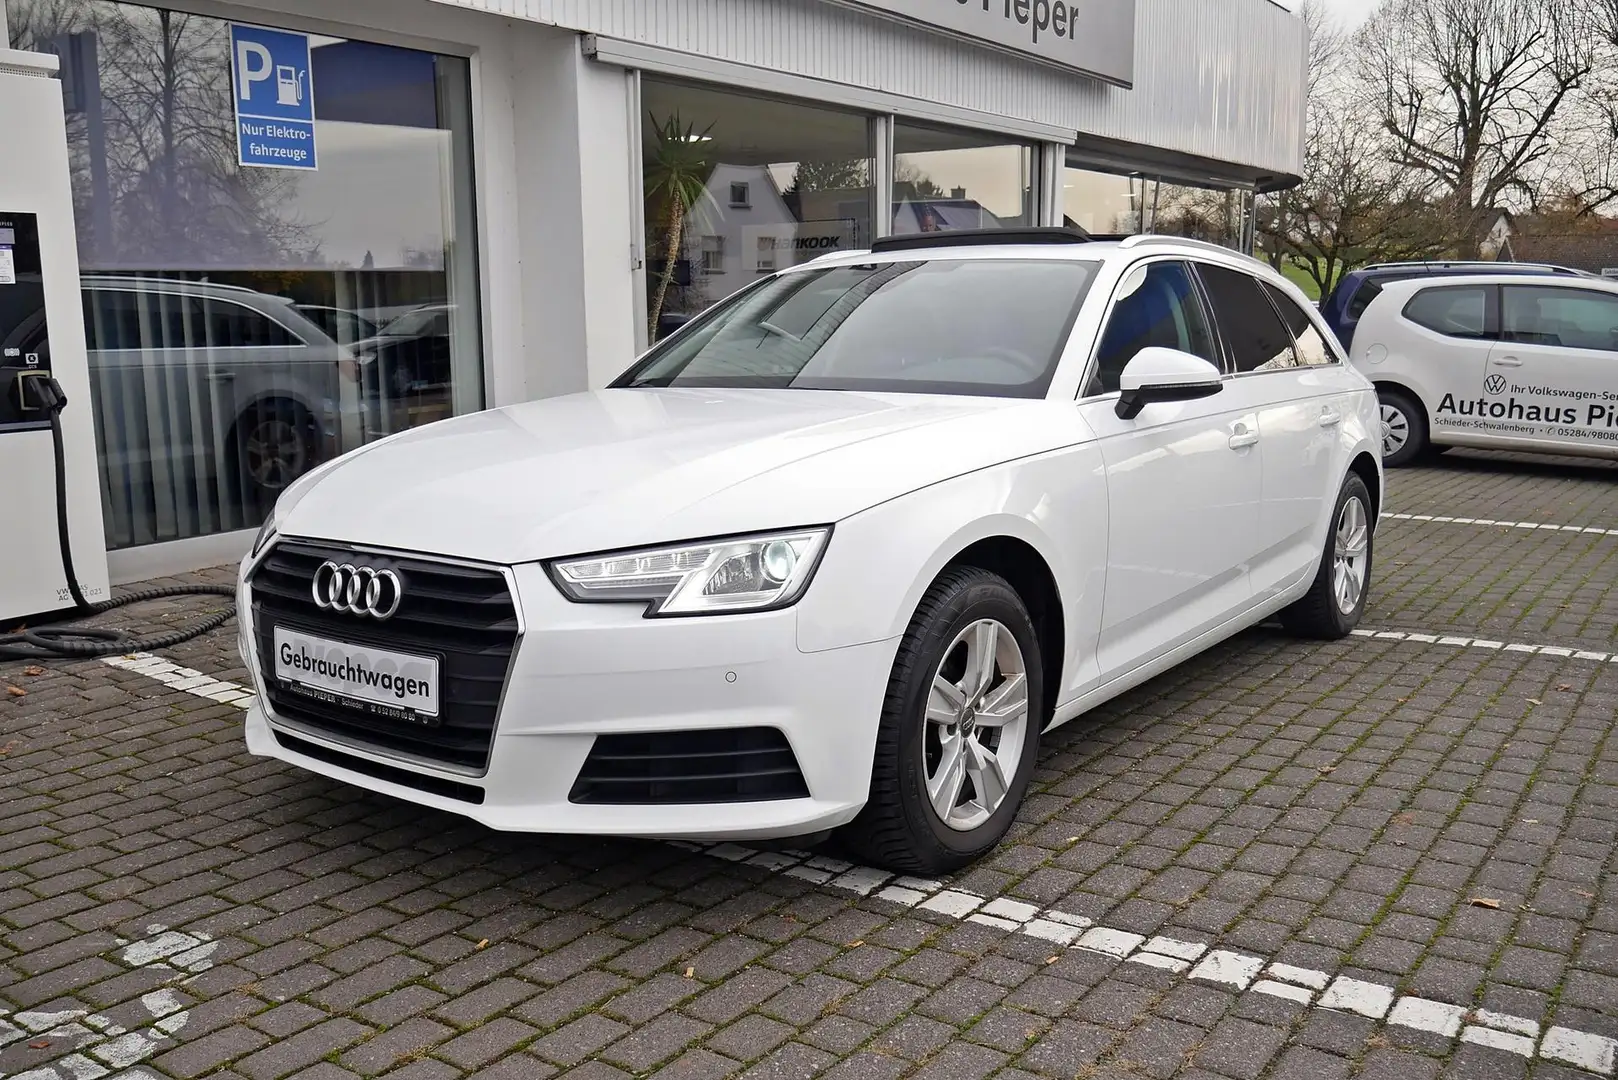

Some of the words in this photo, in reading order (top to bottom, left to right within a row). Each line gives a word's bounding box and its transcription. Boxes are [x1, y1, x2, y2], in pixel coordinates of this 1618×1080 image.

[236, 40, 272, 100] P
[241, 123, 265, 136] Nur
[266, 125, 311, 139] Elektro-
[249, 143, 307, 161] fahrzeuge
[1510, 384, 1526, 394] Ihr
[1436, 393, 1577, 425] Autohaus
[1587, 404, 1618, 427] Pi
[1434, 417, 1535, 434] Schieder-Schwalenberg
[280, 642, 430, 698] Gebrauchtwagen
[313, 690, 336, 703] PIEPER
